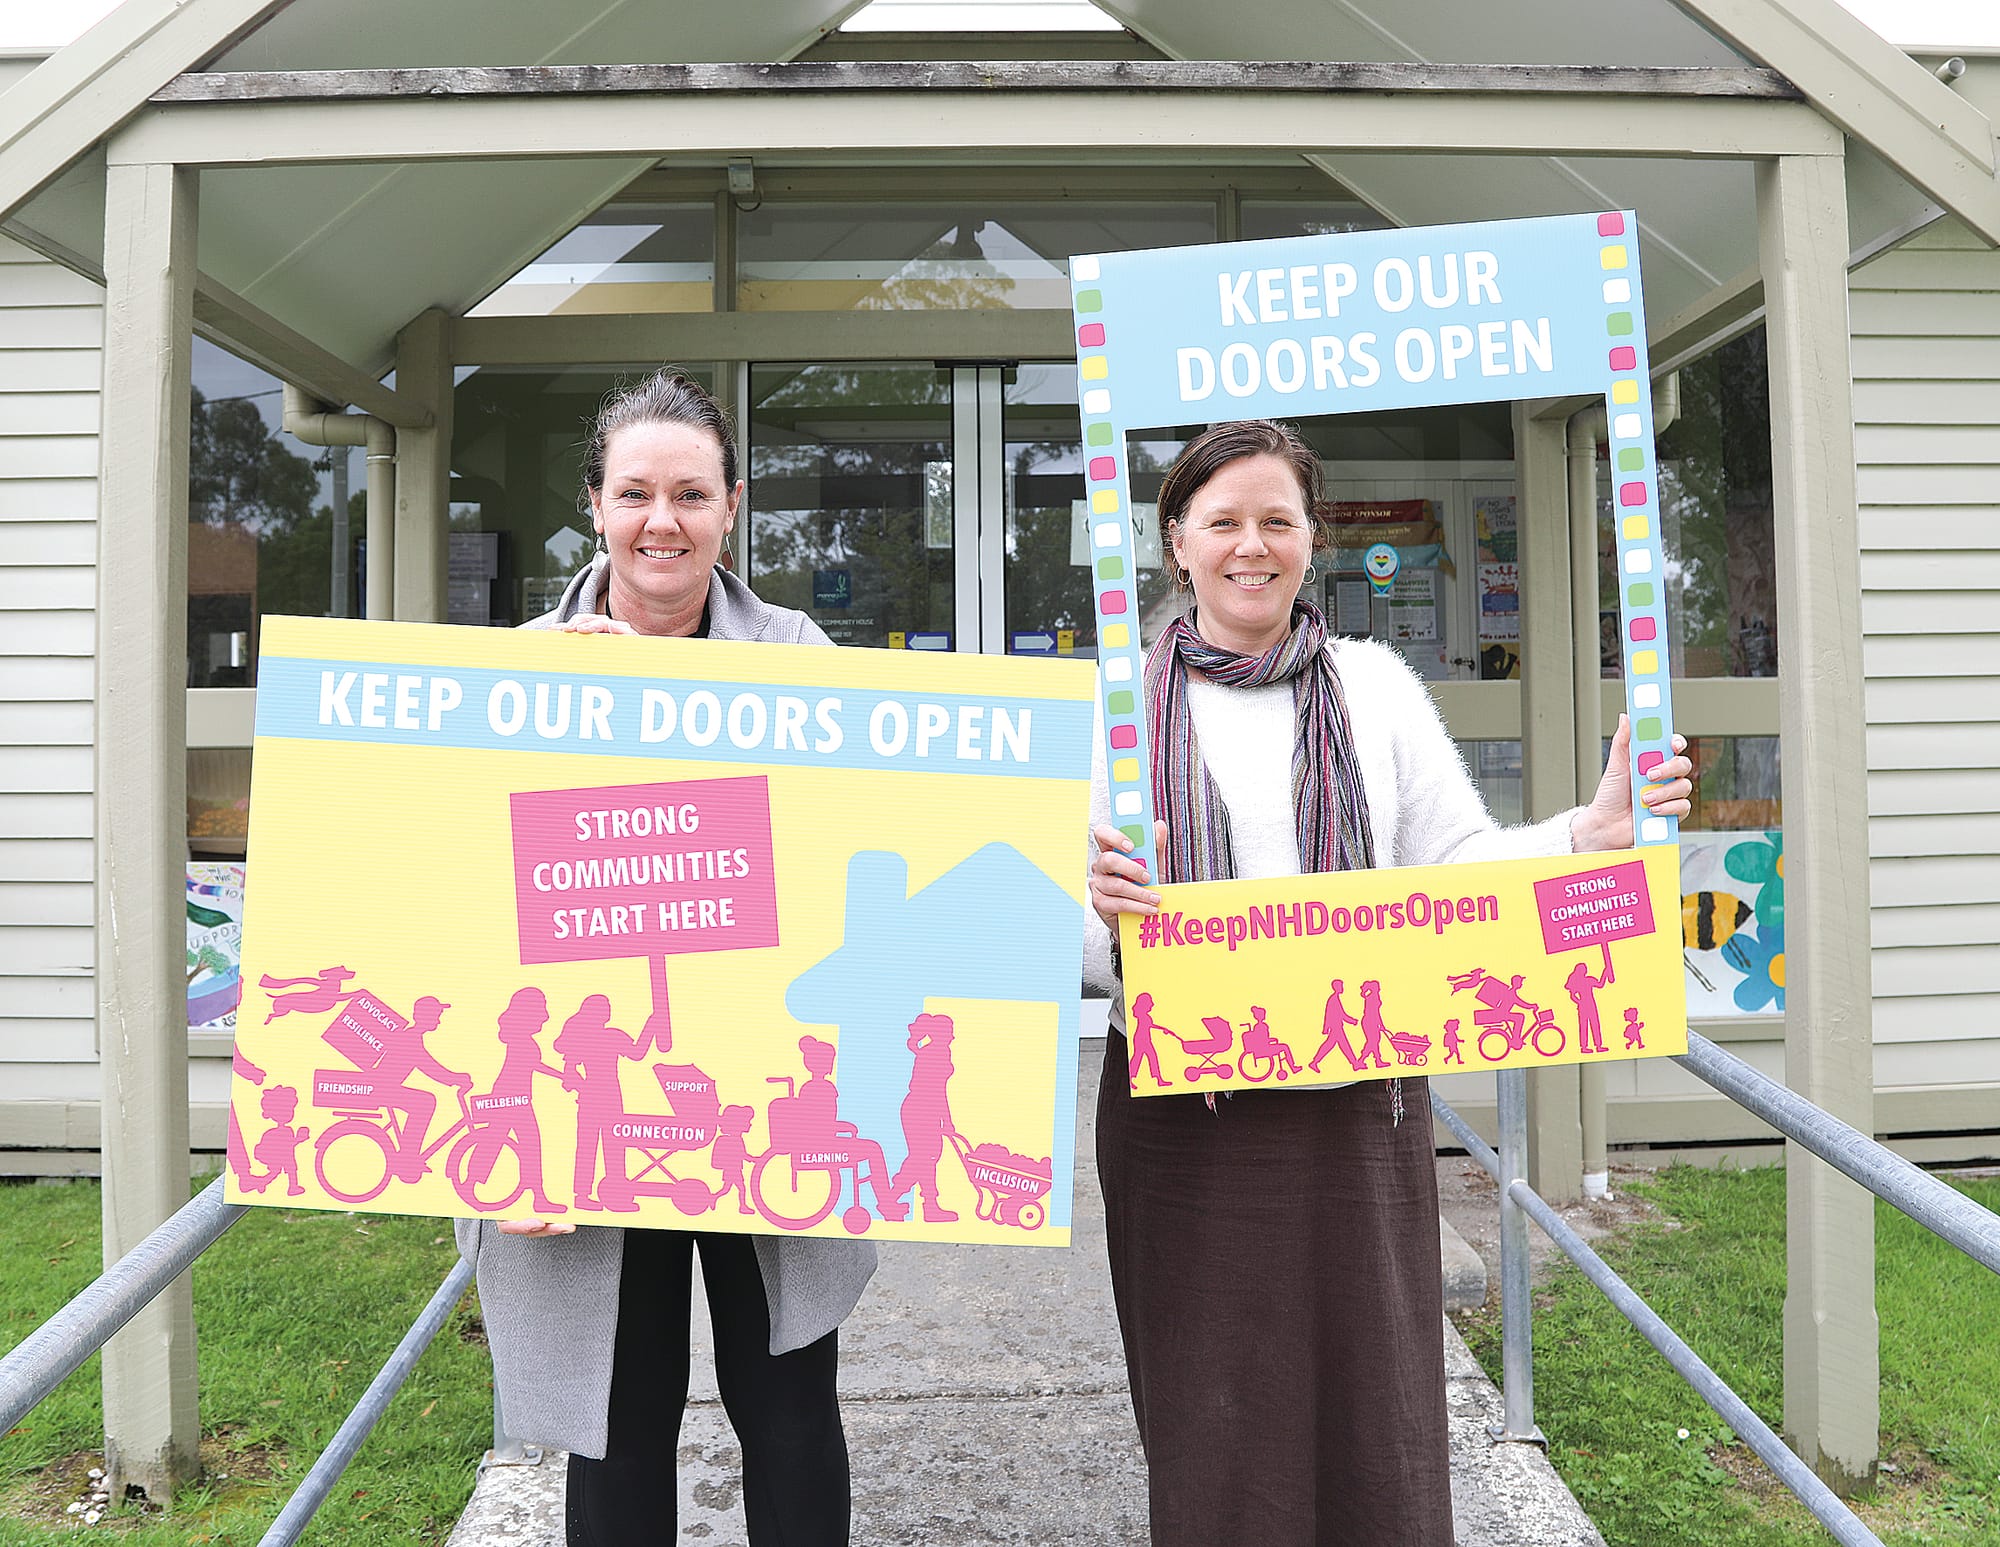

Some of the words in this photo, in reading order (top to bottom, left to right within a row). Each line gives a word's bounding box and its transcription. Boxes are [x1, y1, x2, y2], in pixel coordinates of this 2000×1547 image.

[1218, 262, 1358, 327] KEEP
[1373, 250, 1503, 313] OUR
[1176, 331, 1381, 402] DOORS
[1394, 316, 1553, 383] OPEN
[1367, 546, 1396, 562] WELCOME
[823, 618, 855, 626] COMMUNITY
[319, 670, 463, 732] KEEP
[487, 679, 615, 741] OUR
[639, 688, 844, 754] DOORS
[869, 700, 1032, 763] OPEN
[574, 803, 700, 841] STRONG
[532, 848, 750, 892] COMMUNITIES
[1564, 875, 1616, 898] STRONG
[553, 903, 647, 939] START
[658, 897, 736, 931] HERE
[1550, 891, 1639, 922] COMMUNITIES
[1139, 892, 1499, 951] #KeepNHDoorsOpen
[1561, 920, 1600, 941] START
[1601, 913, 1635, 933] HERE
[190, 924, 240, 950] UPPOR
[357, 997, 399, 1032] ADVOCACY
[341, 1015, 384, 1052] RESILIENCE
[317, 1082, 374, 1096] FRIENDSHIP
[665, 1081, 709, 1093] SUPPORT
[475, 1095, 529, 1110] WELLBEING
[612, 1123, 705, 1142] CONNECTION
[800, 1152, 849, 1164] LEARNING
[975, 1166, 1040, 1194] INCLUSION
